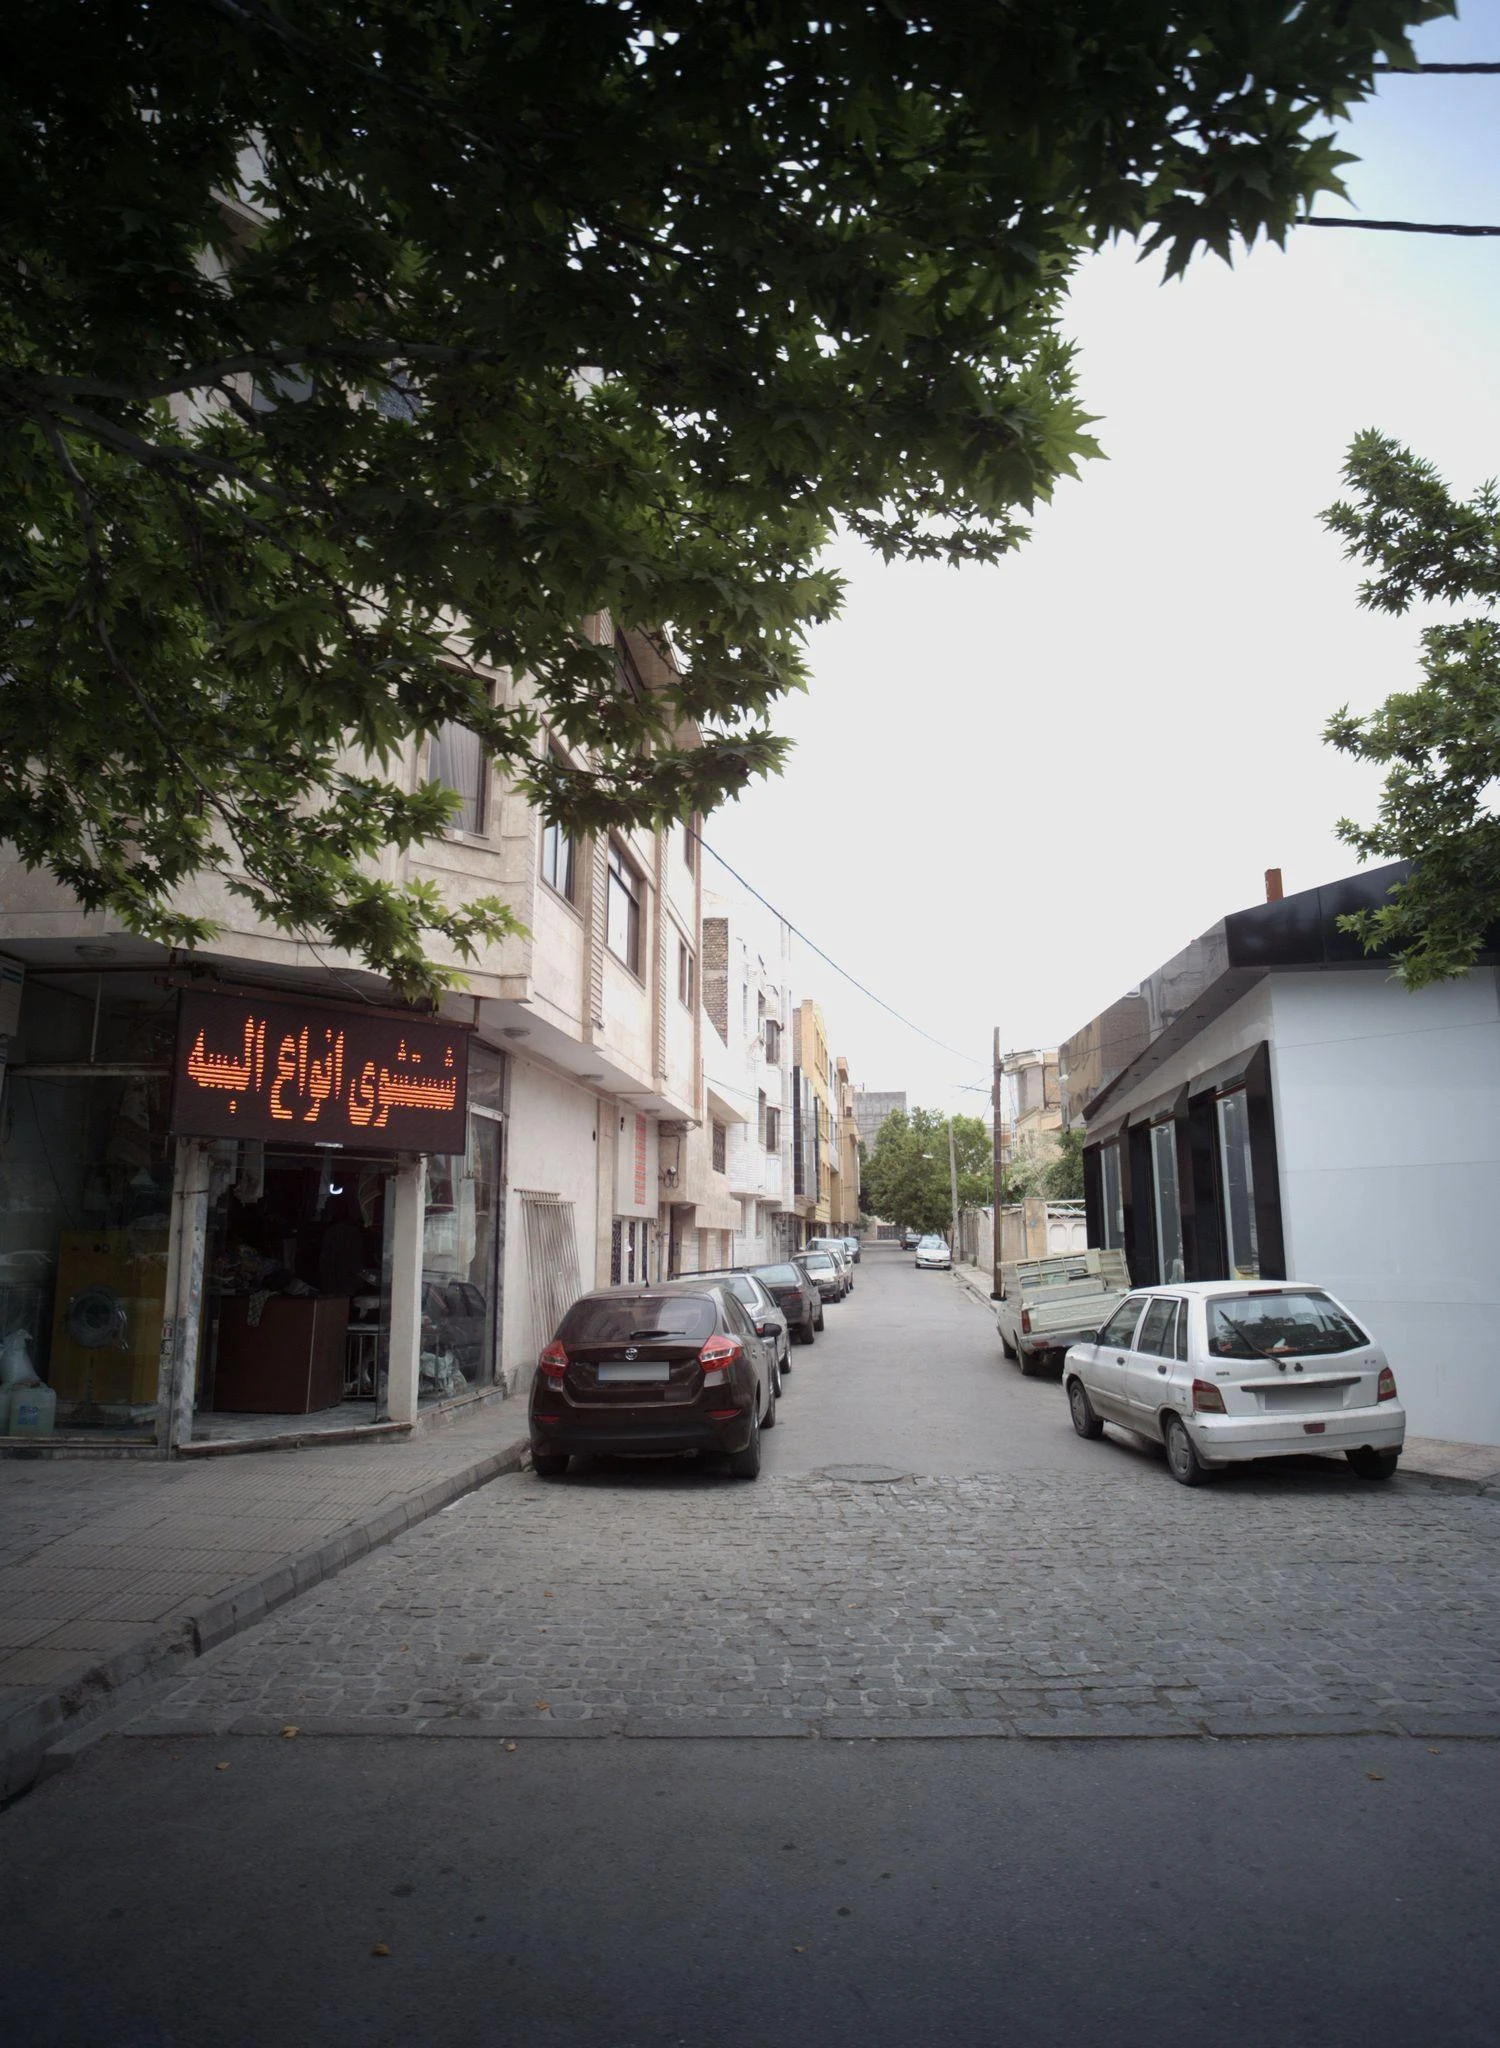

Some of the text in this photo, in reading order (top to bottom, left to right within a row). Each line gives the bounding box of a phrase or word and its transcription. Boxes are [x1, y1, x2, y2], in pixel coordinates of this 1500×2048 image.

[187, 1015, 457, 1128] شستشوی انواع البسه
